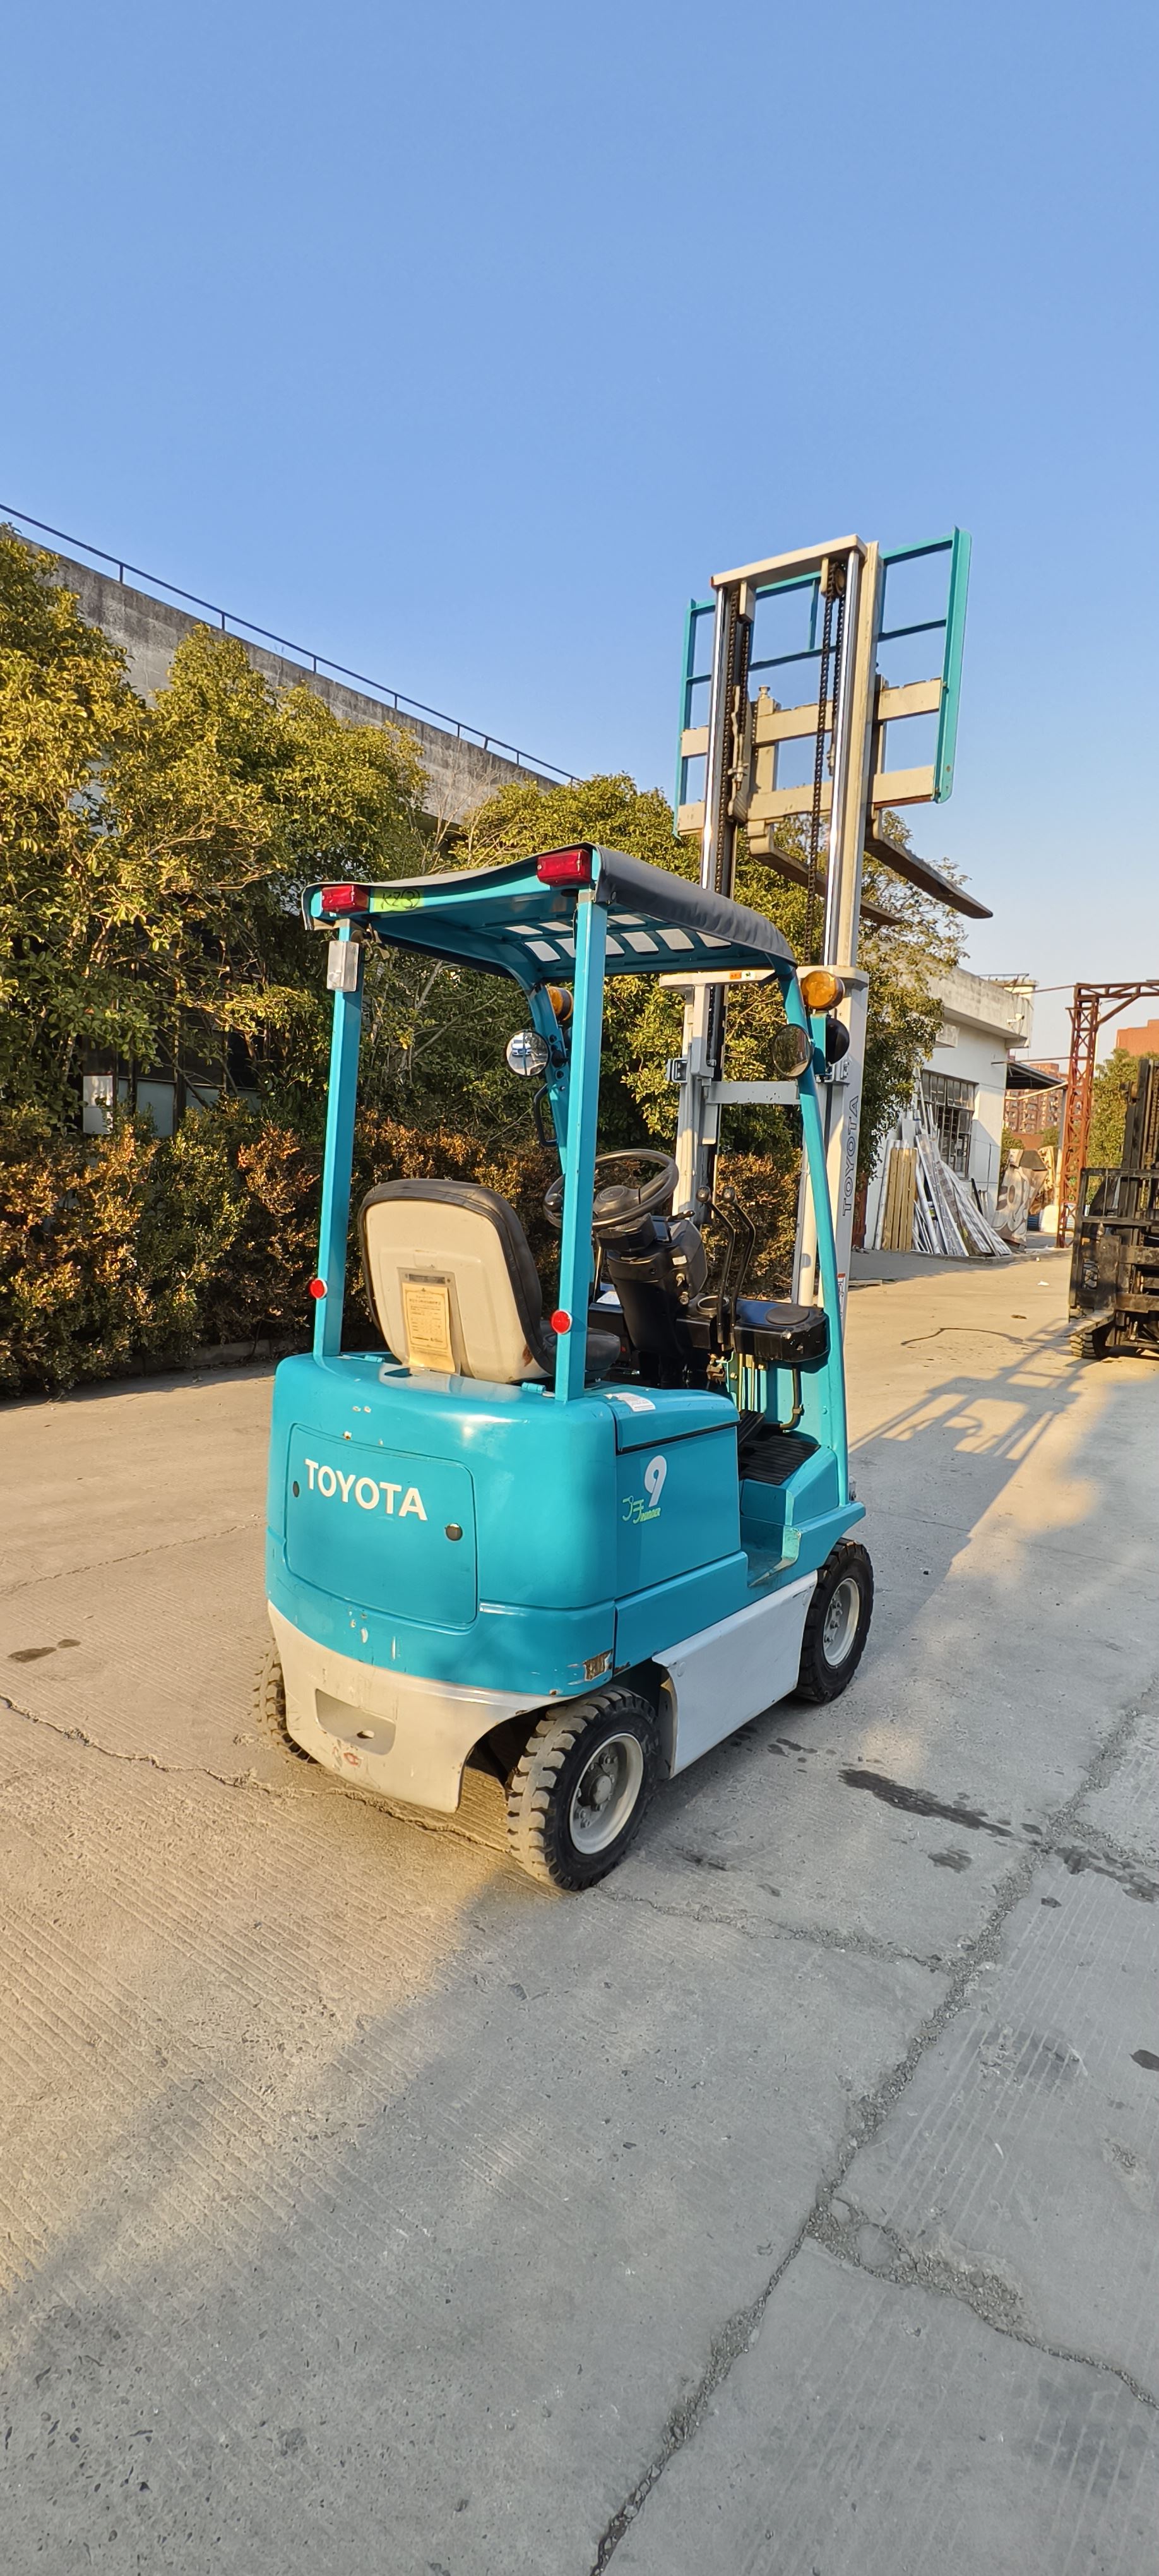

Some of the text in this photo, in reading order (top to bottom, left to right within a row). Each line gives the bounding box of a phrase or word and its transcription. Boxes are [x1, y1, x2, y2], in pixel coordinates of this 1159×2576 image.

[842, 1095, 859, 1216] TOYOTA
[305, 1458, 428, 1521] TOYOTA
[645, 1455, 667, 1508] 9
